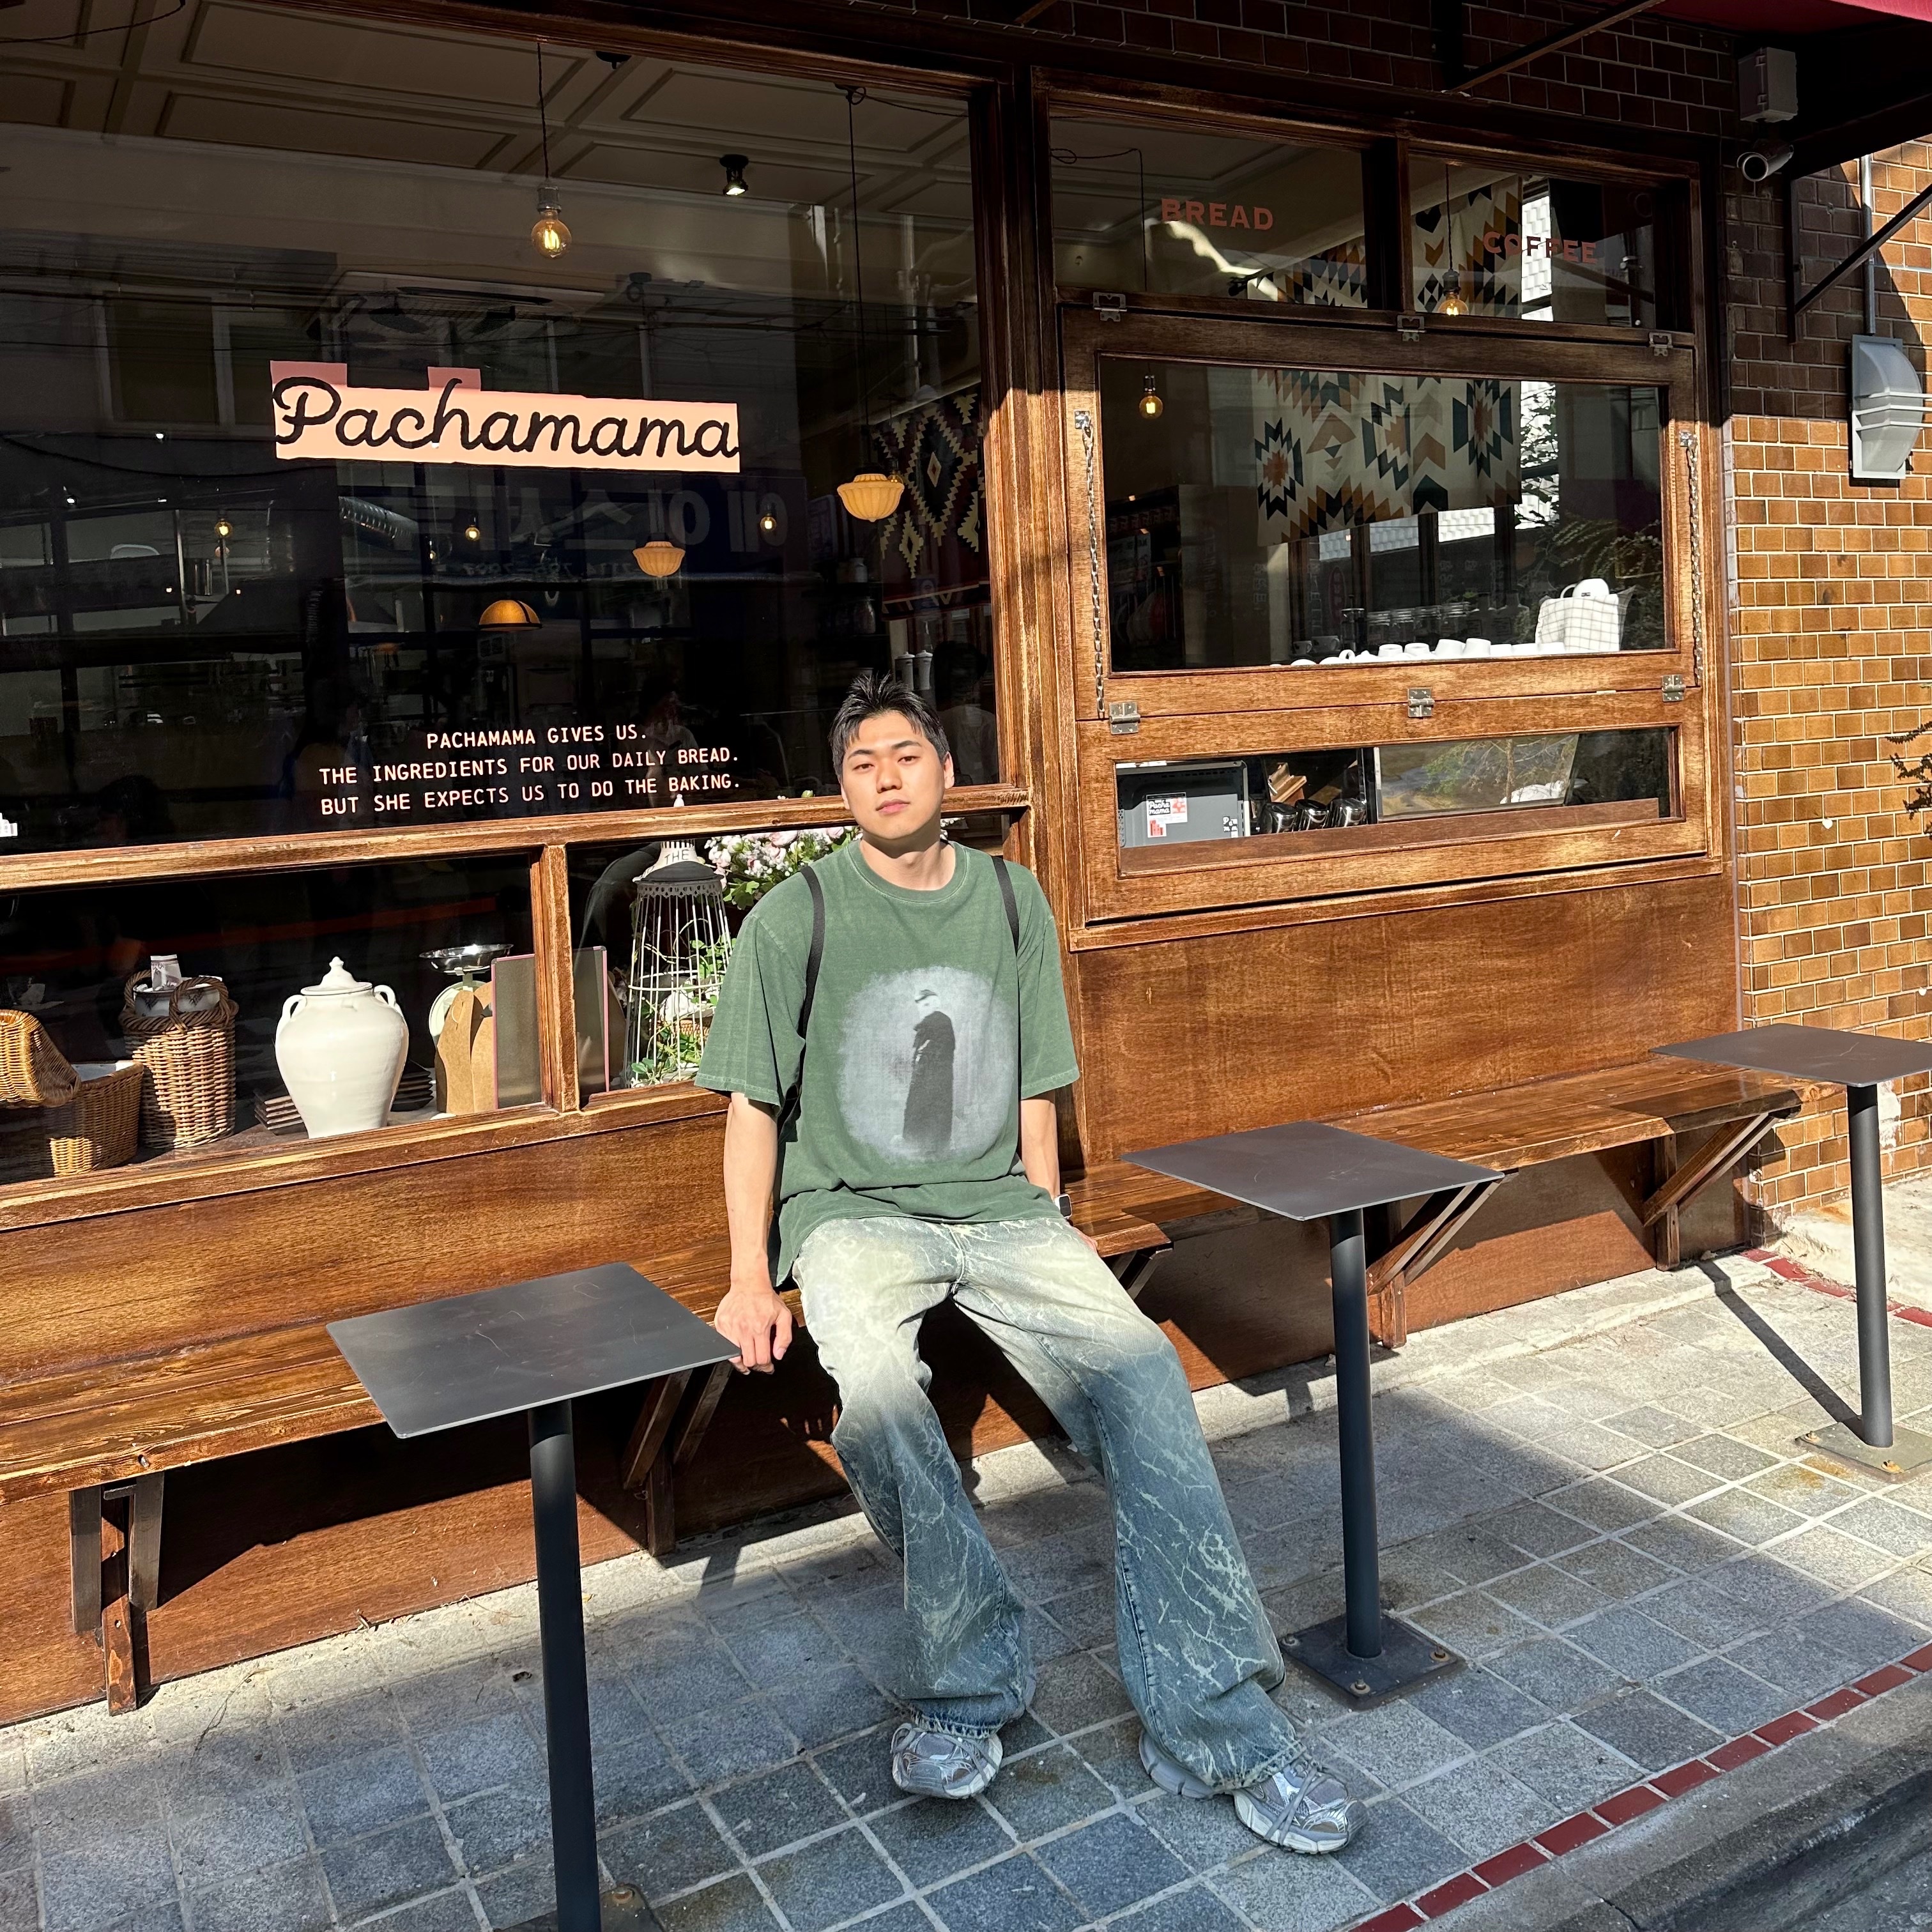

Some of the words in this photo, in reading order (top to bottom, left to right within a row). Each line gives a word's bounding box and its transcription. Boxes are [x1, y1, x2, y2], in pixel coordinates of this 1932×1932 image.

[1161, 198, 1273, 231] BREAD
[1483, 231, 1597, 264] COFFEE
[272, 376, 740, 457] Pachamama
[427, 729, 536, 749] PACHAMAMA
[548, 726, 604, 744] GIVES
[616, 724, 646, 740] US.
[319, 767, 357, 785] THE
[373, 758, 507, 782] INGREDIENTS
[520, 756, 555, 773] FOR
[567, 753, 601, 770] OUR
[612, 750, 666, 767] DAILY
[678, 747, 738, 764] BREAD.
[321, 797, 359, 815] BUT
[374, 793, 411, 812] SHE
[424, 787, 509, 808] EXPECTS
[521, 785, 544, 801] US
[557, 783, 579, 799] TO
[592, 781, 613, 797] DO
[625, 778, 657, 794] THE
[668, 774, 739, 792] BAKING.
[1148, 800, 1170, 809] Pacha
[664, 849, 689, 864] THE
